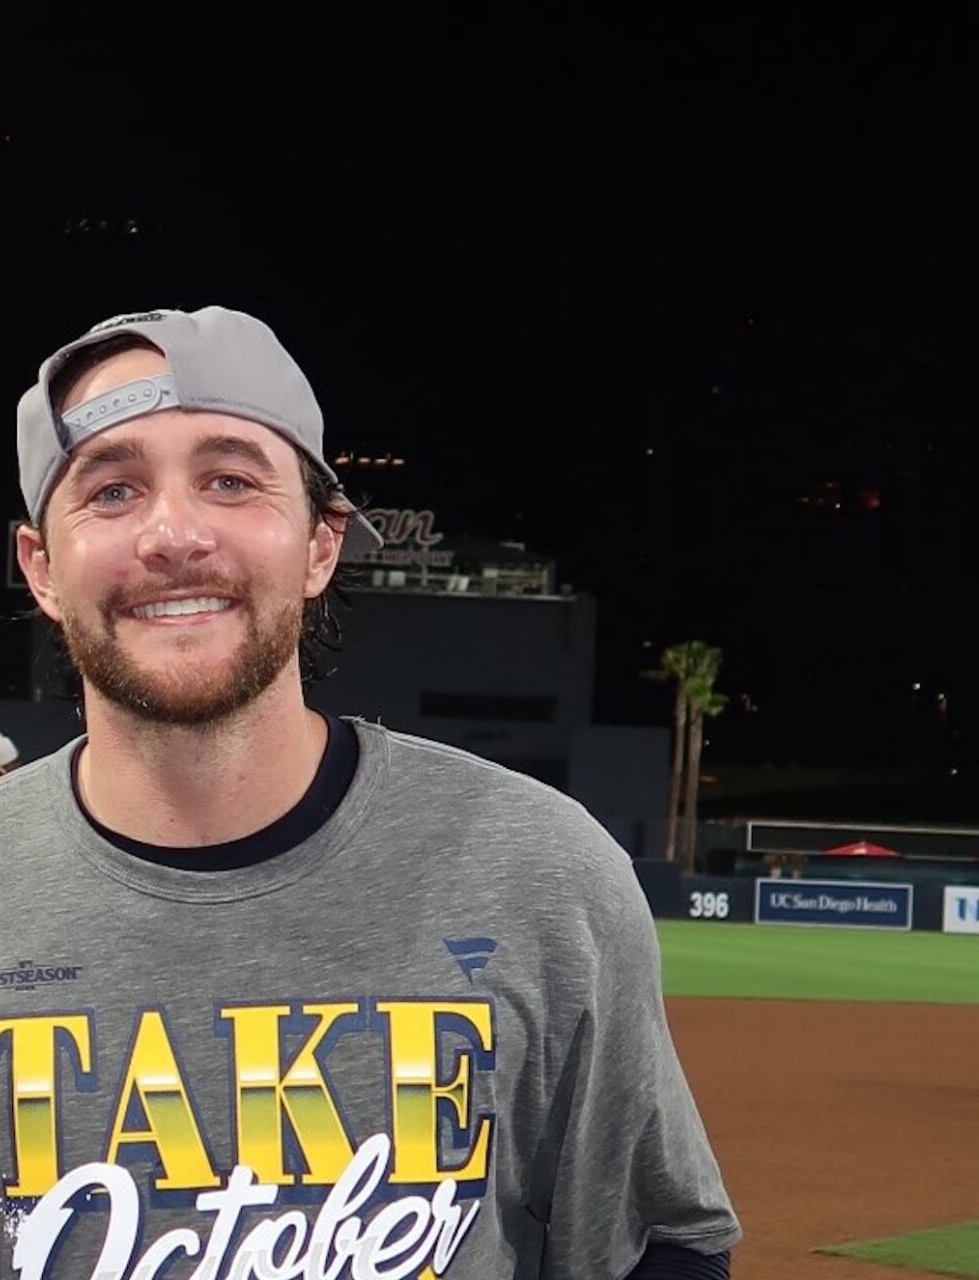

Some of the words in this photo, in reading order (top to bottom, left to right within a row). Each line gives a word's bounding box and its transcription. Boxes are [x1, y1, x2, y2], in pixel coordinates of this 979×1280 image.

[689, 891, 730, 918] 396
[770, 893, 792, 909] UC
[793, 894, 817, 911] San
[818, 894, 855, 913] Diego
[856, 896, 898, 913] Health
